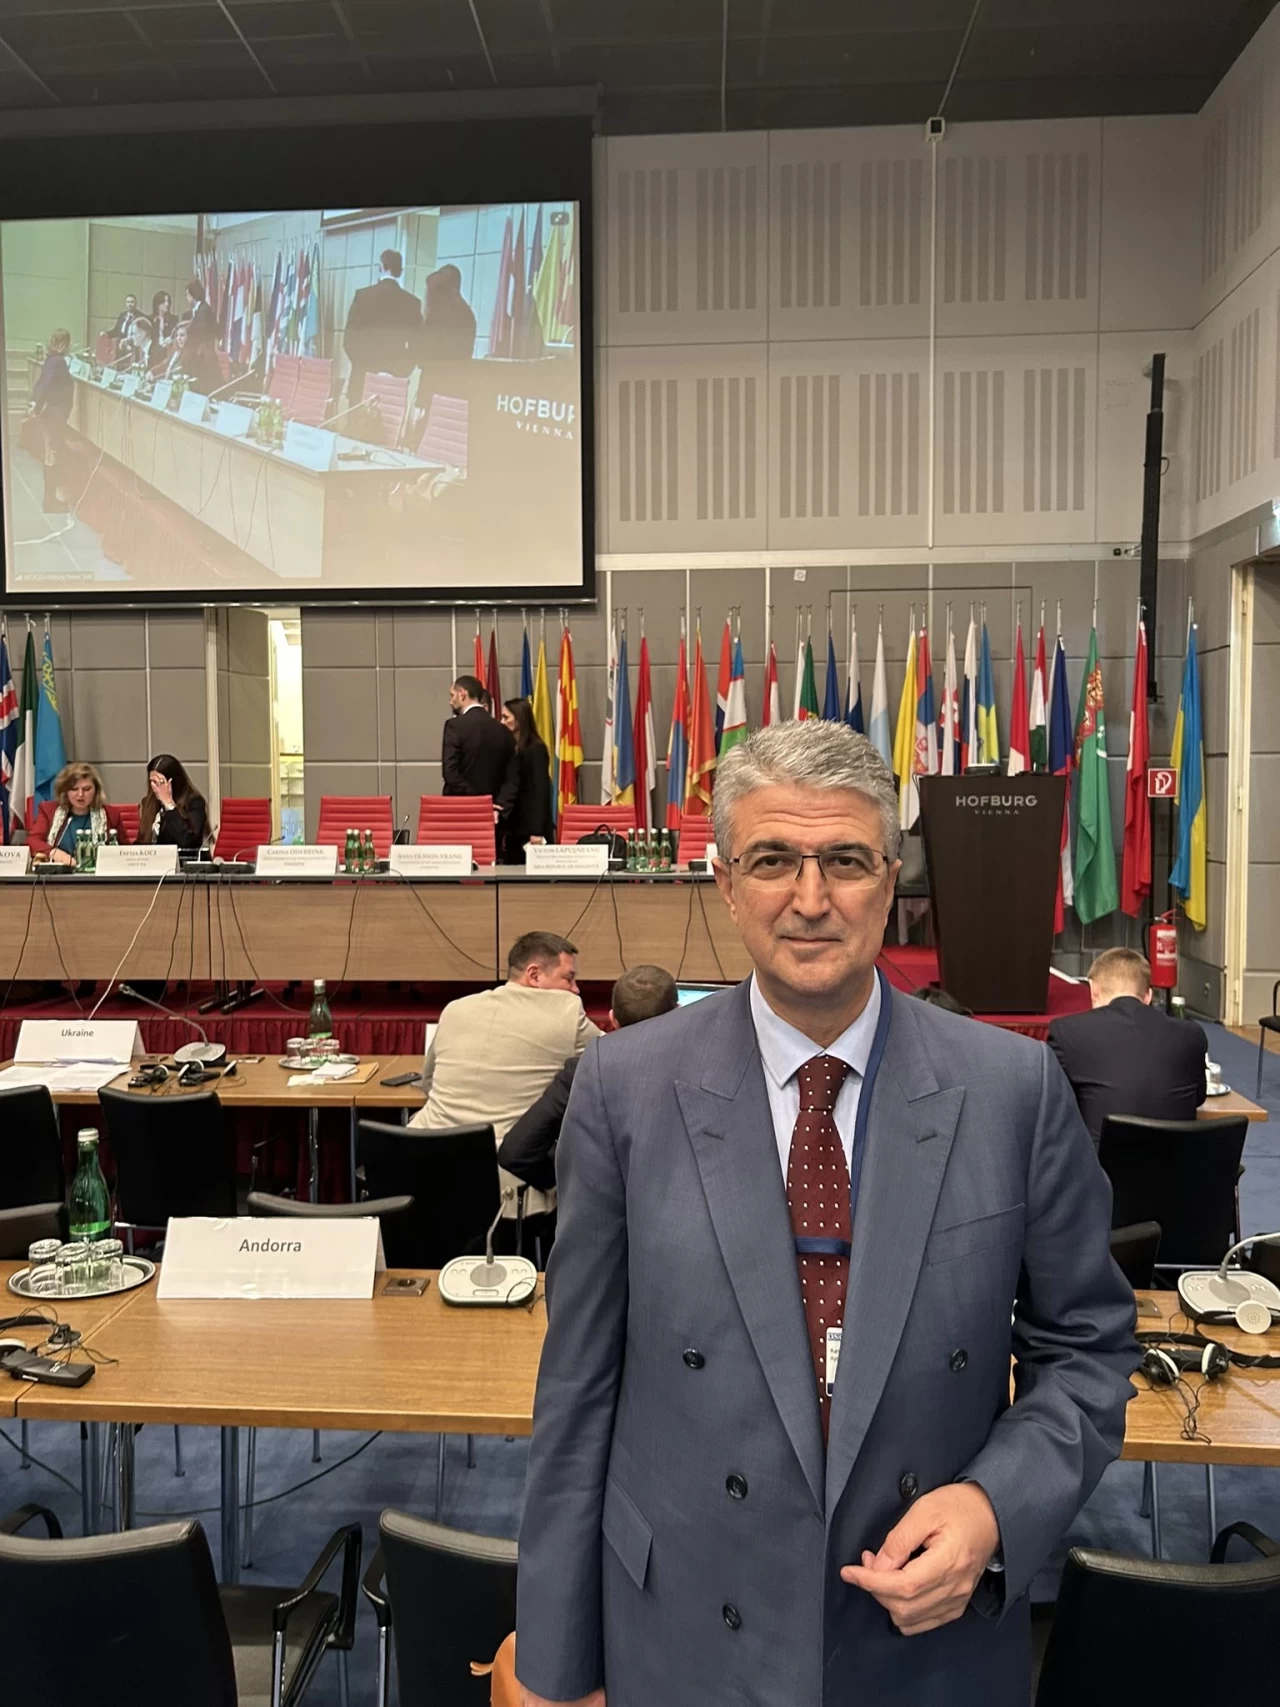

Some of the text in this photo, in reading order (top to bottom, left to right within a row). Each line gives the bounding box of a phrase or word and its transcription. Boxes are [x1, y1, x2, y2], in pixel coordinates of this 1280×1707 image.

[516, 420, 573, 440] VIENNA
[956, 795, 1037, 807] HOFBURG
[61, 1028, 94, 1037] Ukraine
[239, 1238, 302, 1252] Andorra
